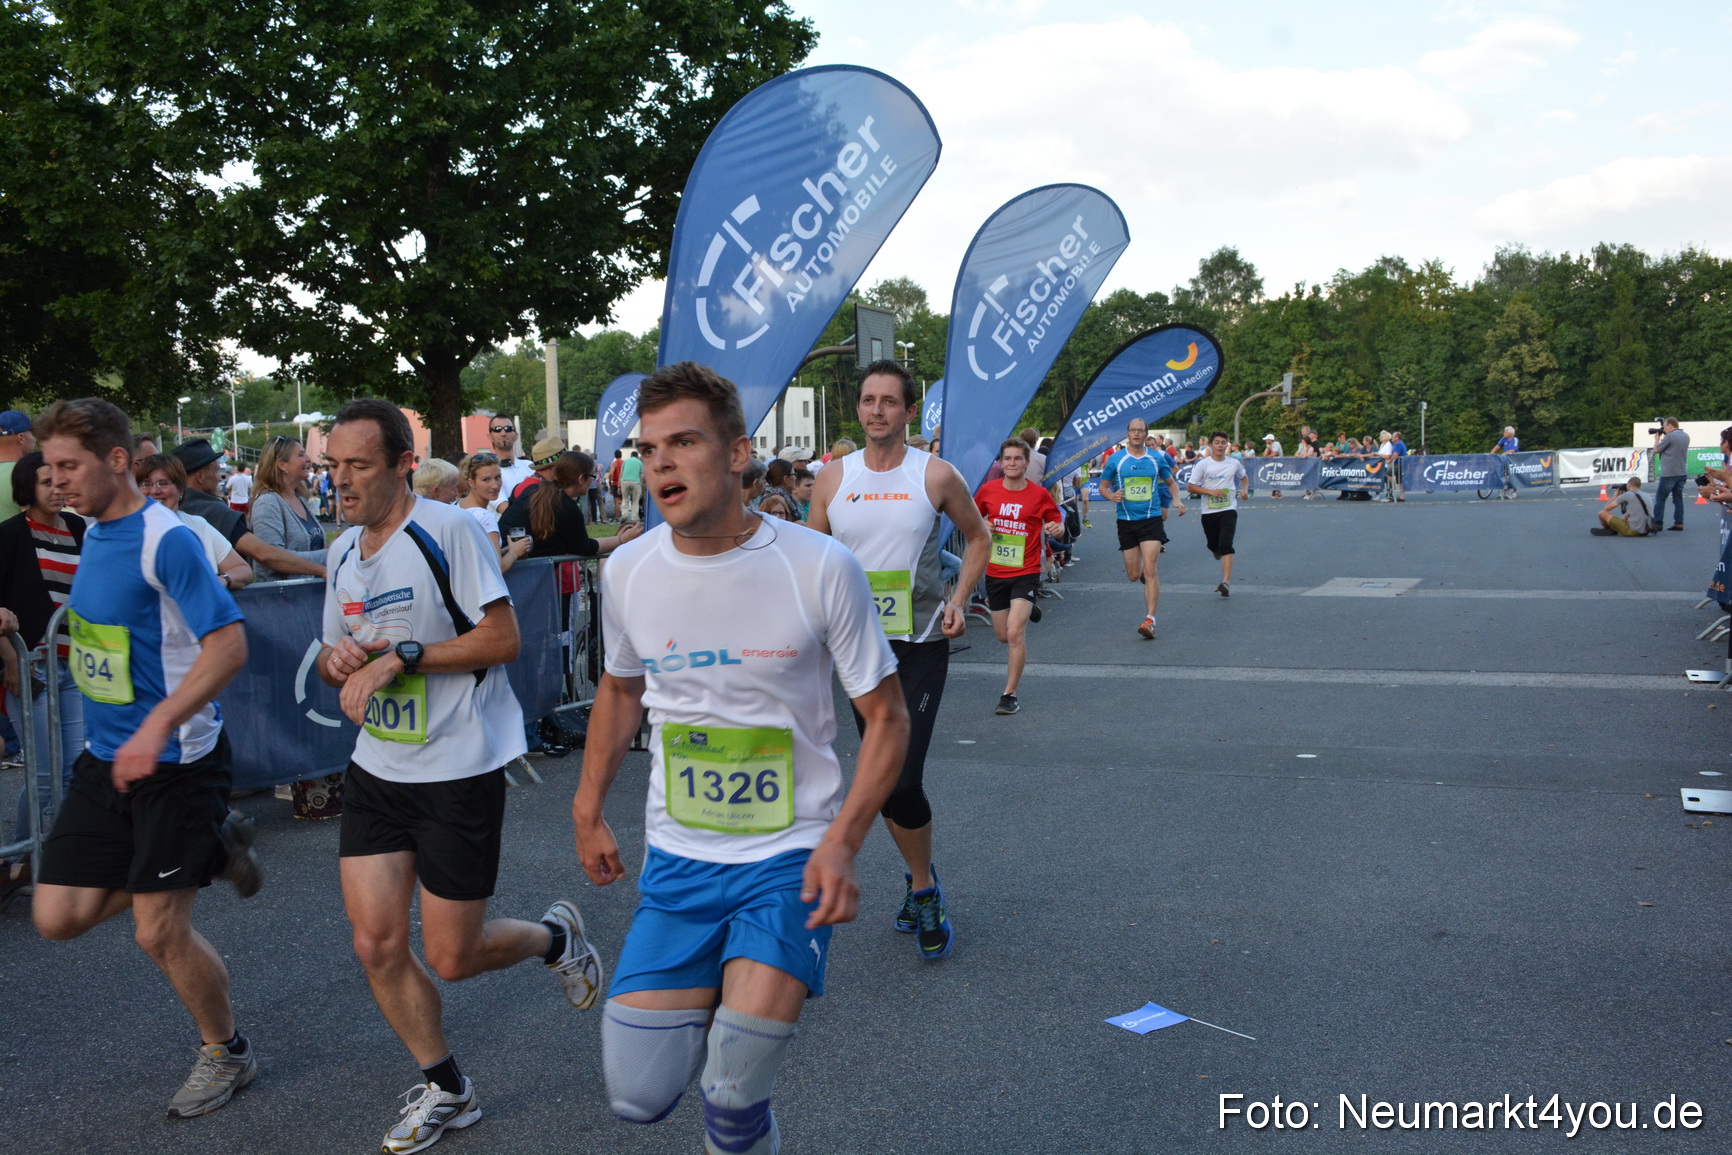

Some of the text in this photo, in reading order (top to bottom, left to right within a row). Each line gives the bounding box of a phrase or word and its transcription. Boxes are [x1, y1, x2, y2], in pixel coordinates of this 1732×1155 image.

[732, 115, 880, 315] Fischer
[786, 155, 897, 313] AUTOMOBILE
[991, 215, 1088, 356] Fischer
[1027, 240, 1100, 354] AUTOMOBILE
[1072, 372, 1177, 436] Frischmann
[1140, 366, 1214, 409] Druck und Medien
[610, 384, 640, 429] Fische
[1130, 486, 1147, 495] 524
[1266, 470, 1304, 481] Fischer
[1435, 469, 1488, 480] Fischer
[1000, 503, 1022, 520] MRT
[996, 546, 1016, 558] 951
[76, 648, 114, 682] 794
[742, 646, 798, 658] energie
[365, 696, 416, 730] 2001
[680, 766, 780, 804] 1326
